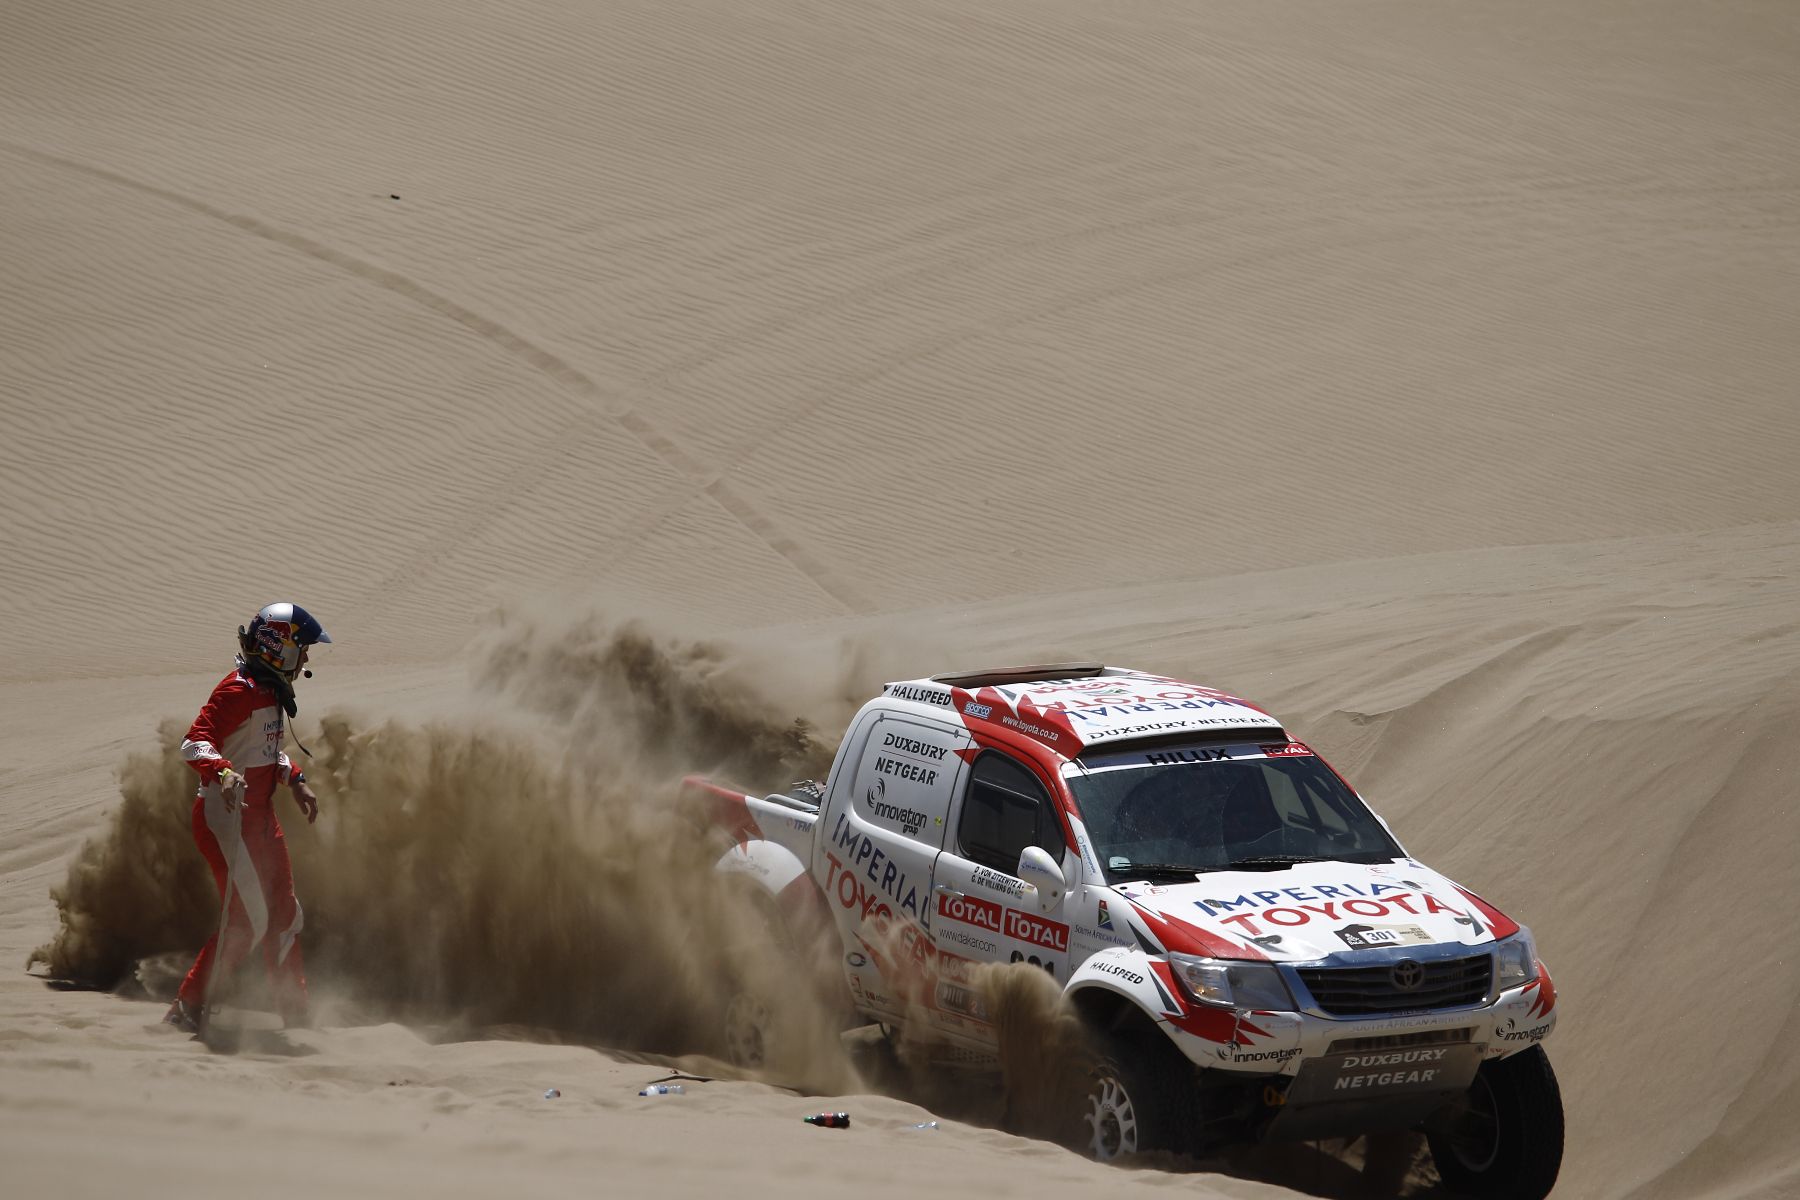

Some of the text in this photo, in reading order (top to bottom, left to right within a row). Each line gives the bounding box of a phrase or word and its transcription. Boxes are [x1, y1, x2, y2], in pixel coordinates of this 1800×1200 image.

[891, 685, 951, 706] HALLSPEED
[963, 701, 992, 718] sparco
[1002, 715, 1060, 742] www.toyota.co.za
[1089, 716, 1269, 741] DUXBURY NETGEAR
[883, 733, 948, 760] DUXBURY
[1146, 748, 1234, 766] HILUX
[875, 757, 937, 786] NETGEAR
[874, 801, 928, 829] innovation
[903, 822, 919, 836] group
[832, 813, 930, 930] IMPERIAL
[1193, 883, 1407, 917] IMPERIA
[1219, 893, 1465, 935] TOYOTA
[939, 928, 997, 954] www.dakar.com
[1008, 909, 1066, 948] TOTAL
[1366, 930, 1397, 941] 301
[1091, 962, 1143, 984] HALLSPEED
[1234, 1048, 1303, 1063] innovation
[1341, 1048, 1448, 1068] DUXBURY
[1333, 1070, 1434, 1090] NETGEAR
